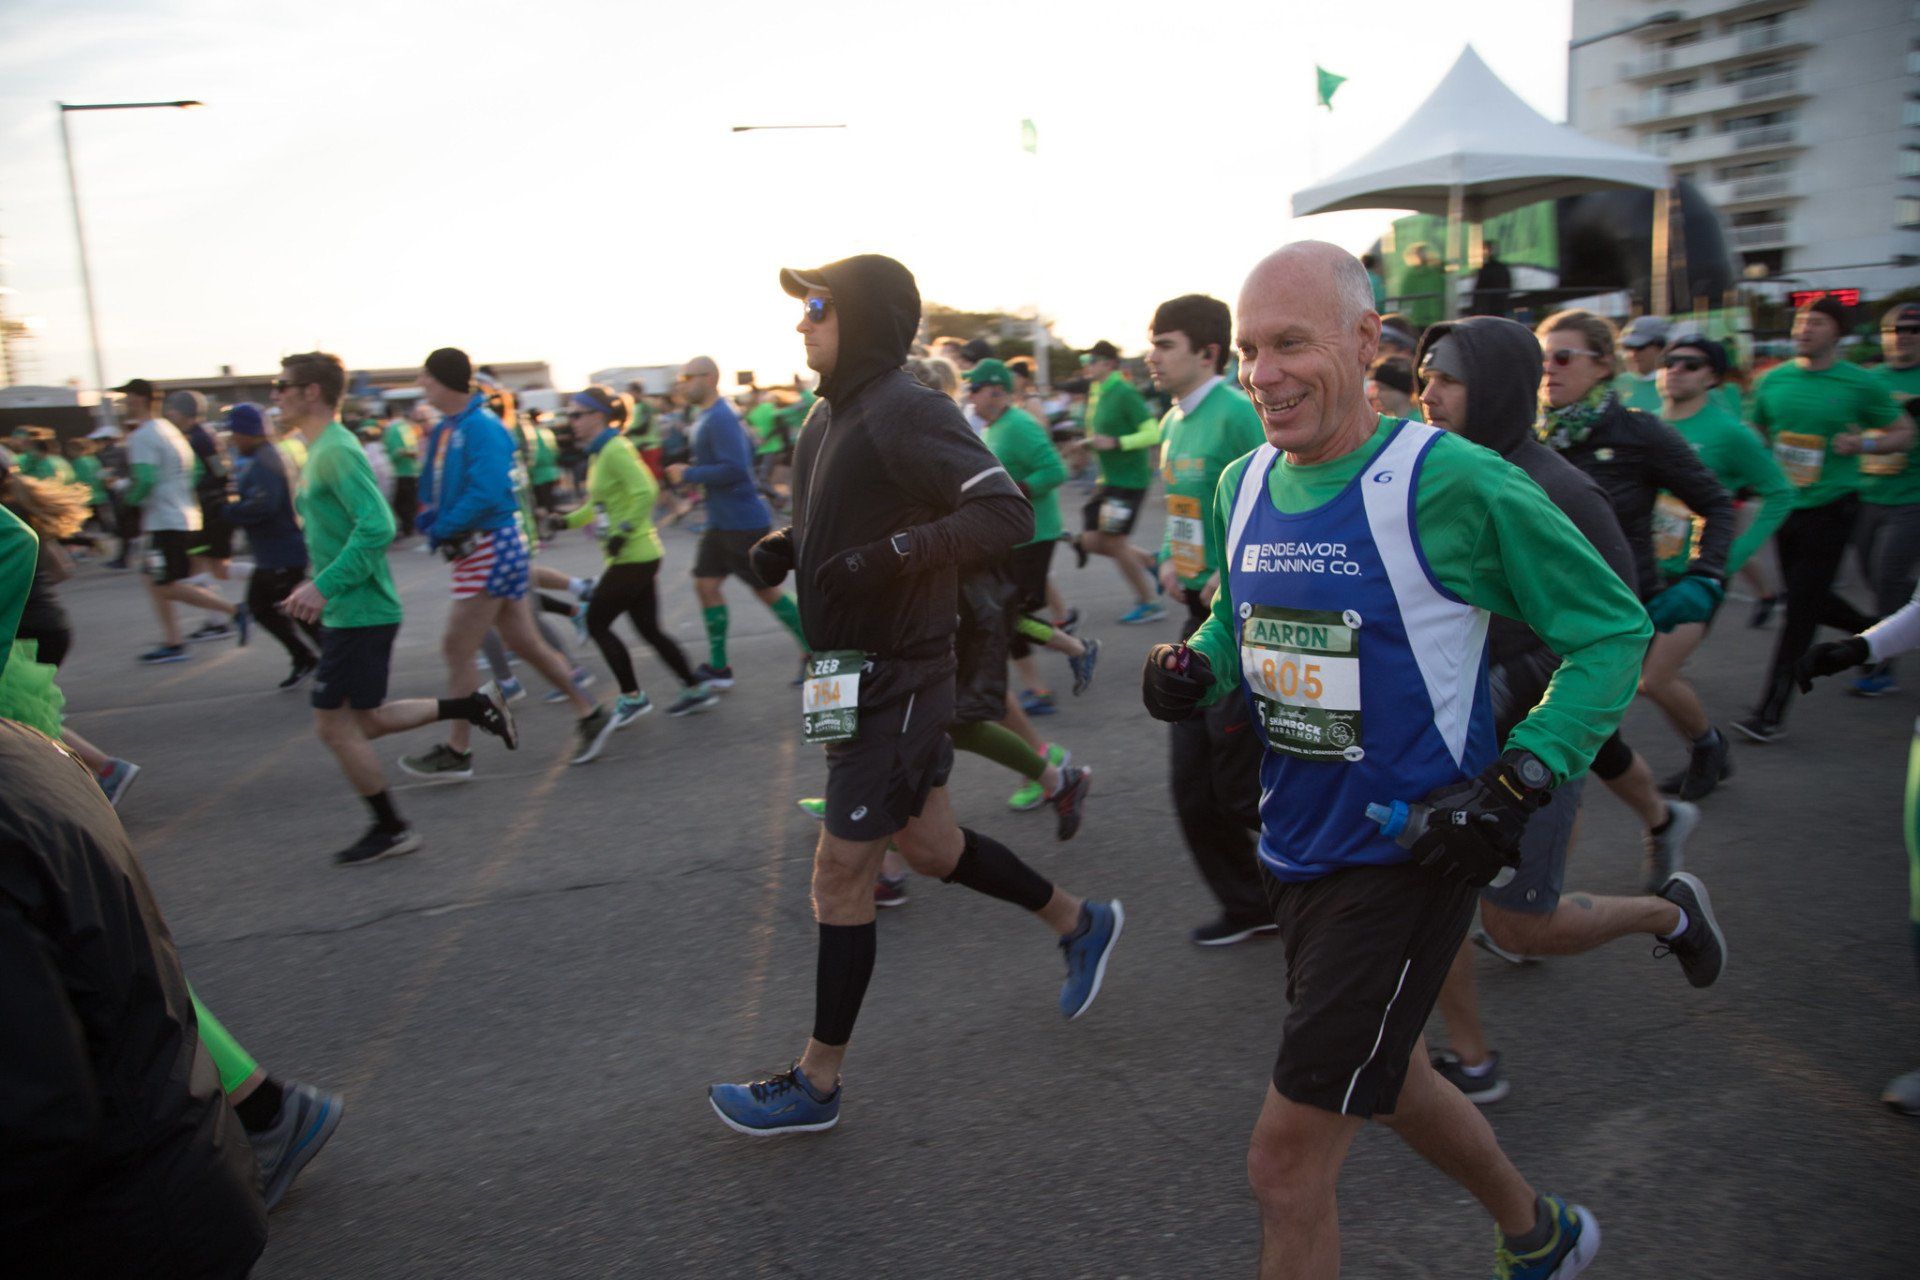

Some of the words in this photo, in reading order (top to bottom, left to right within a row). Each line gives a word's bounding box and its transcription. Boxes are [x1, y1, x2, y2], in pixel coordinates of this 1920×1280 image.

[1260, 541, 1347, 558] ENDEAVOR
[1258, 558, 1325, 574] RUNNING
[1329, 560, 1362, 576] CO.
[1254, 620, 1328, 649] AARON
[814, 658, 840, 675] ZEB
[1262, 658, 1323, 700] 805
[1269, 717, 1322, 736] SHAMROCK
[1269, 726, 1321, 743] MARATHON
